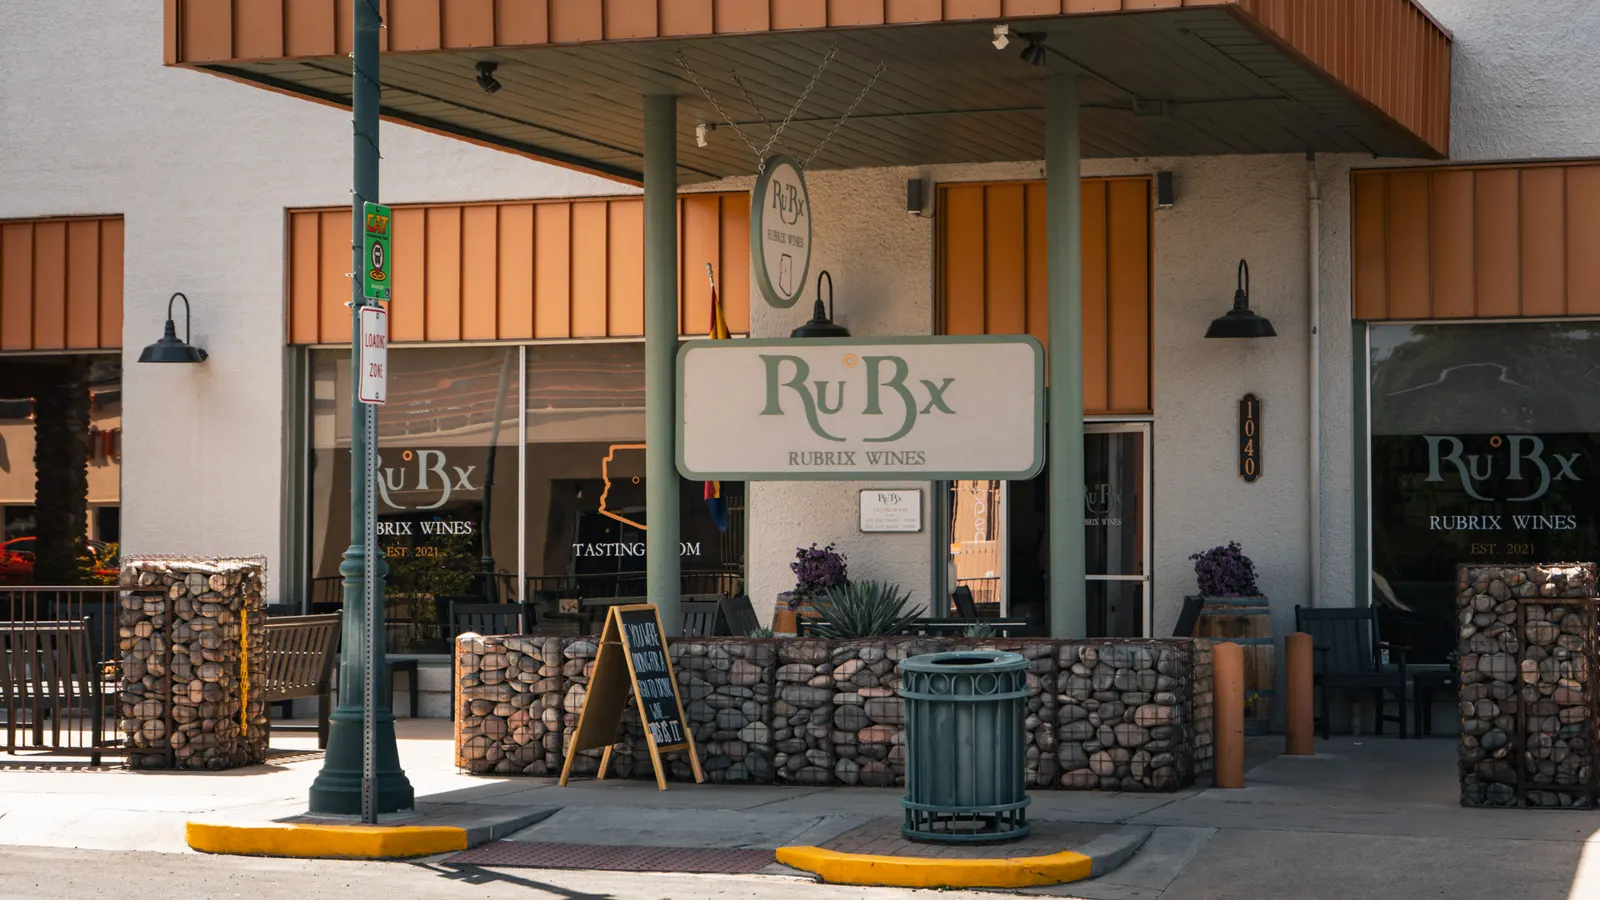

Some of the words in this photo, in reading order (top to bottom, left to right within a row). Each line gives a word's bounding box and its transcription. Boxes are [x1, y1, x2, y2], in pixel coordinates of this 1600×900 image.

[366, 213, 389, 235] CAT
[787, 234, 804, 248] WINES
[365, 332, 386, 348] LOADING
[369, 362, 383, 378] ZONE
[1244, 401, 1255, 475] 1040
[788, 451, 856, 466] RUBRIX
[865, 451, 926, 466] WINES
[376, 521, 412, 535] BRIX
[420, 521, 472, 535] WINES
[1429, 515, 1502, 530] RUBRIX
[1512, 515, 1577, 530] WINES
[415, 547, 438, 557] 2021
[573, 542, 646, 557] TASTING
[1507, 543, 1535, 555] 2021
